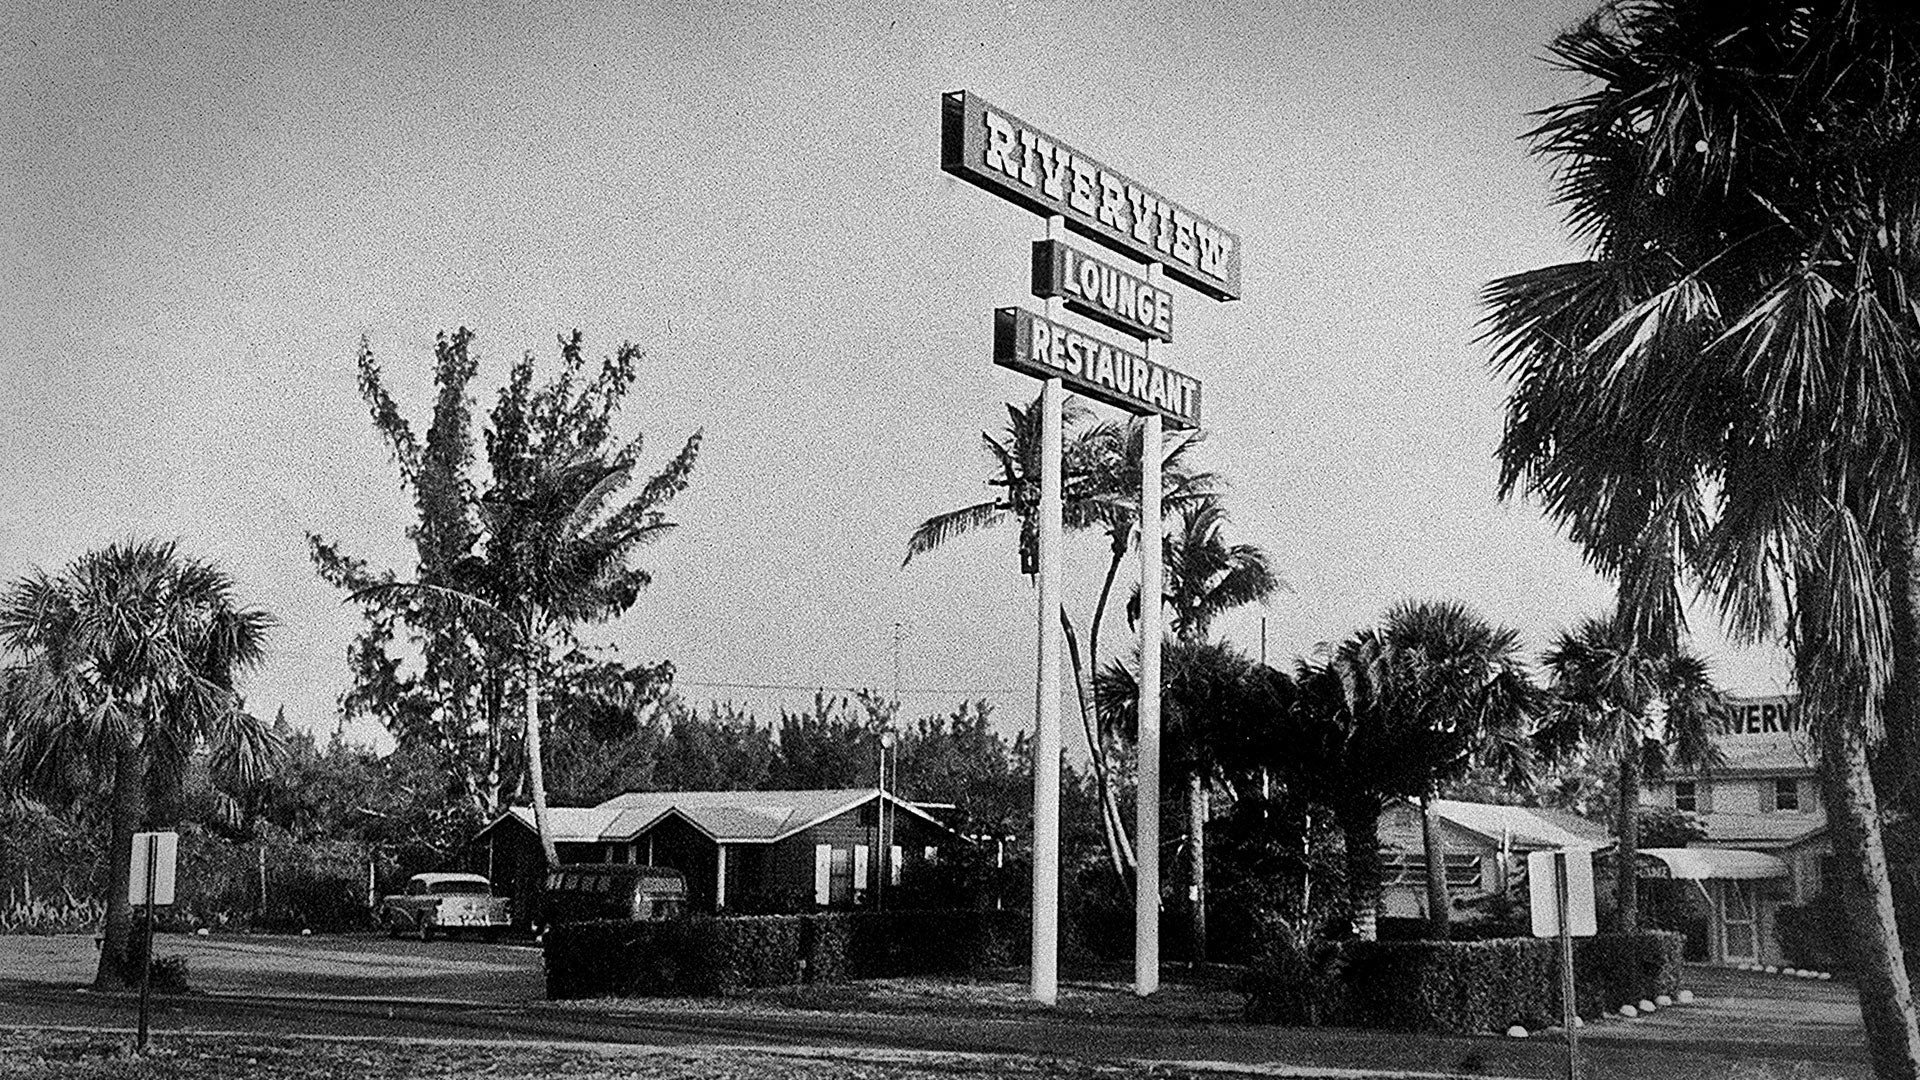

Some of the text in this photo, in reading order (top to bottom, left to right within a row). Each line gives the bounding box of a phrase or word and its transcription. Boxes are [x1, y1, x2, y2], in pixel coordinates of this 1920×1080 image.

[986, 111, 1233, 282] RIVERVIEW
[1064, 250, 1170, 333] LOUNGE
[1032, 317, 1196, 418] RESTAURANT
